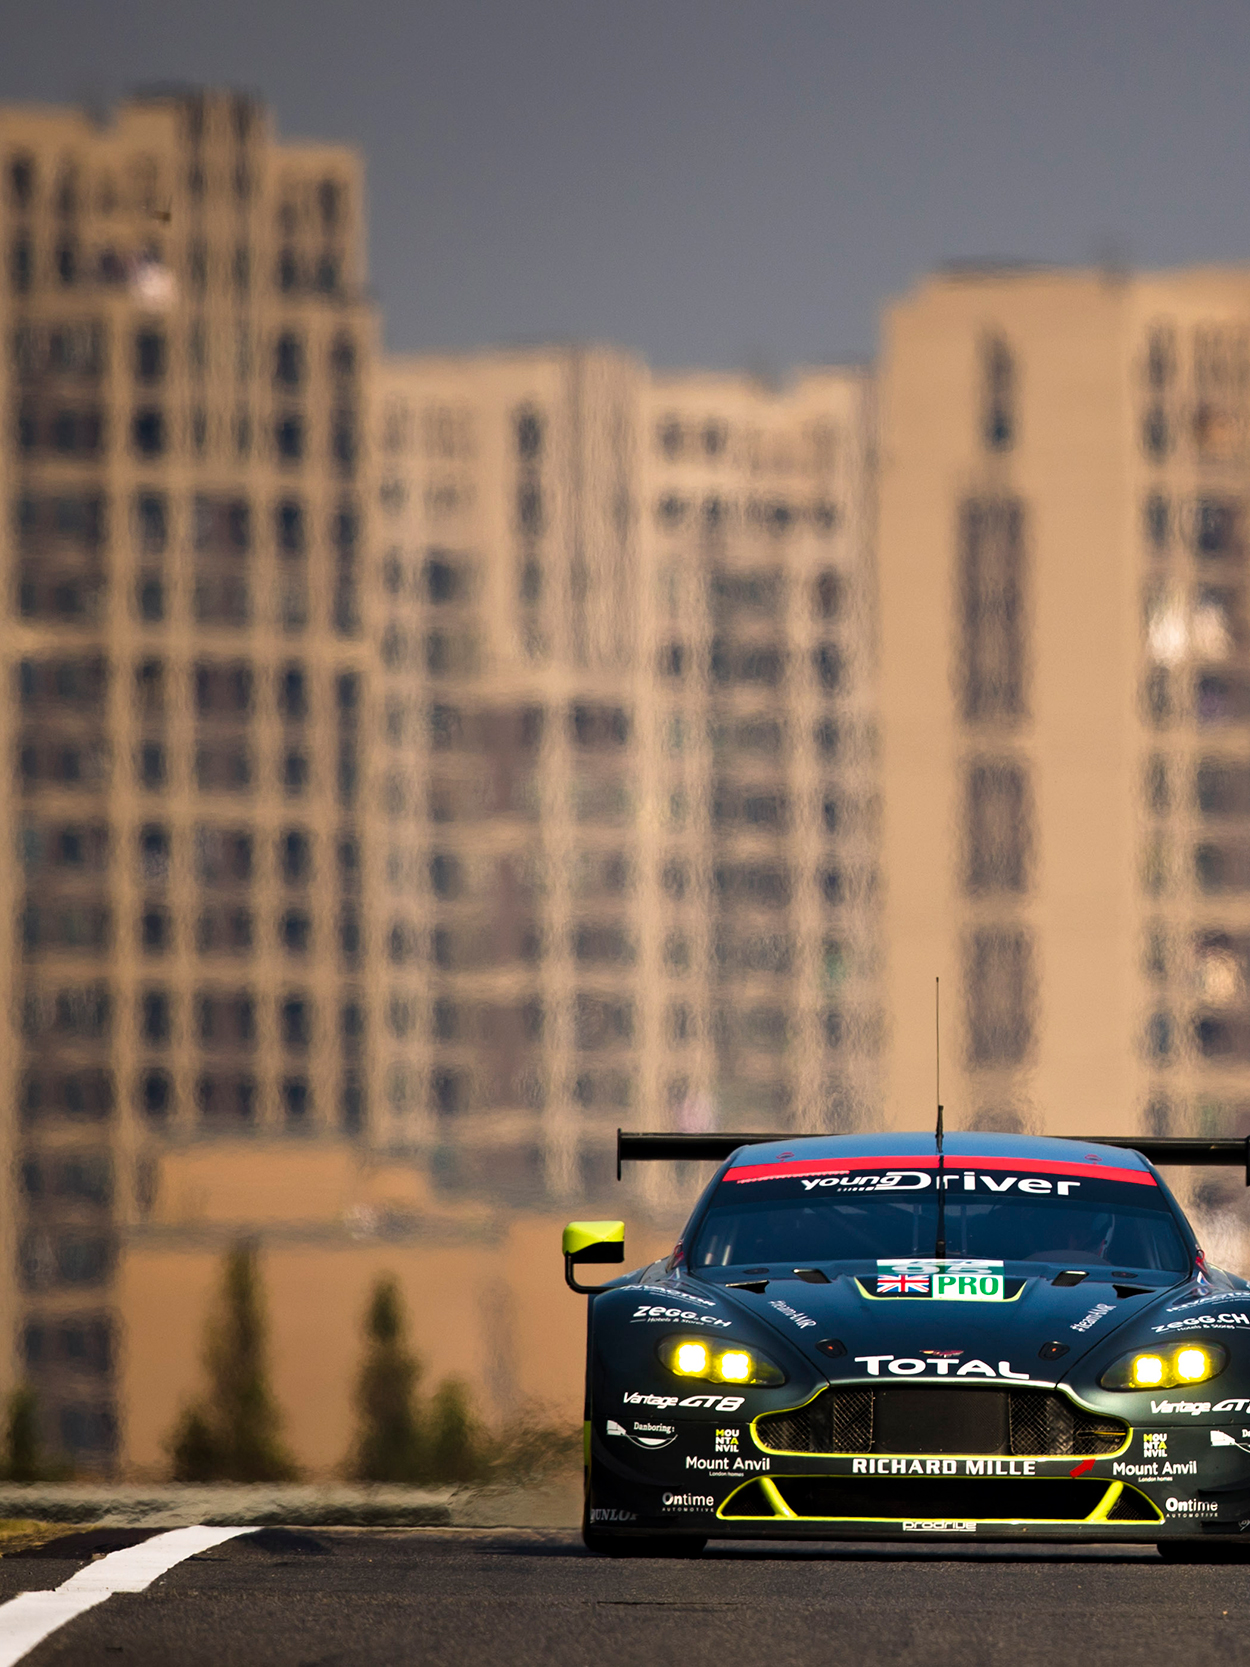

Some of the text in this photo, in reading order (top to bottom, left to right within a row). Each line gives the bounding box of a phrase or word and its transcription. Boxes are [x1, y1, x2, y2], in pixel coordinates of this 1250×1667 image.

[938, 1277, 999, 1296] PRO
[854, 1355, 1030, 1380] TOTAL
[623, 1392, 746, 1412] Vantage GT8
[1150, 1400, 1211, 1416] Vantage
[715, 1429, 739, 1437] MOU
[1143, 1433, 1168, 1442] MOU
[715, 1437, 738, 1445] NTA
[1143, 1441, 1168, 1450] NTA
[1143, 1449, 1168, 1458] NVIL
[686, 1456, 771, 1471] Mount Anvil
[852, 1458, 1036, 1476] RICHARD MILLE
[1112, 1460, 1198, 1476] Mount Anvil
[662, 1492, 714, 1506] Ontime
[1165, 1498, 1218, 1512] Ontime
[902, 1520, 977, 1531] prodrive
